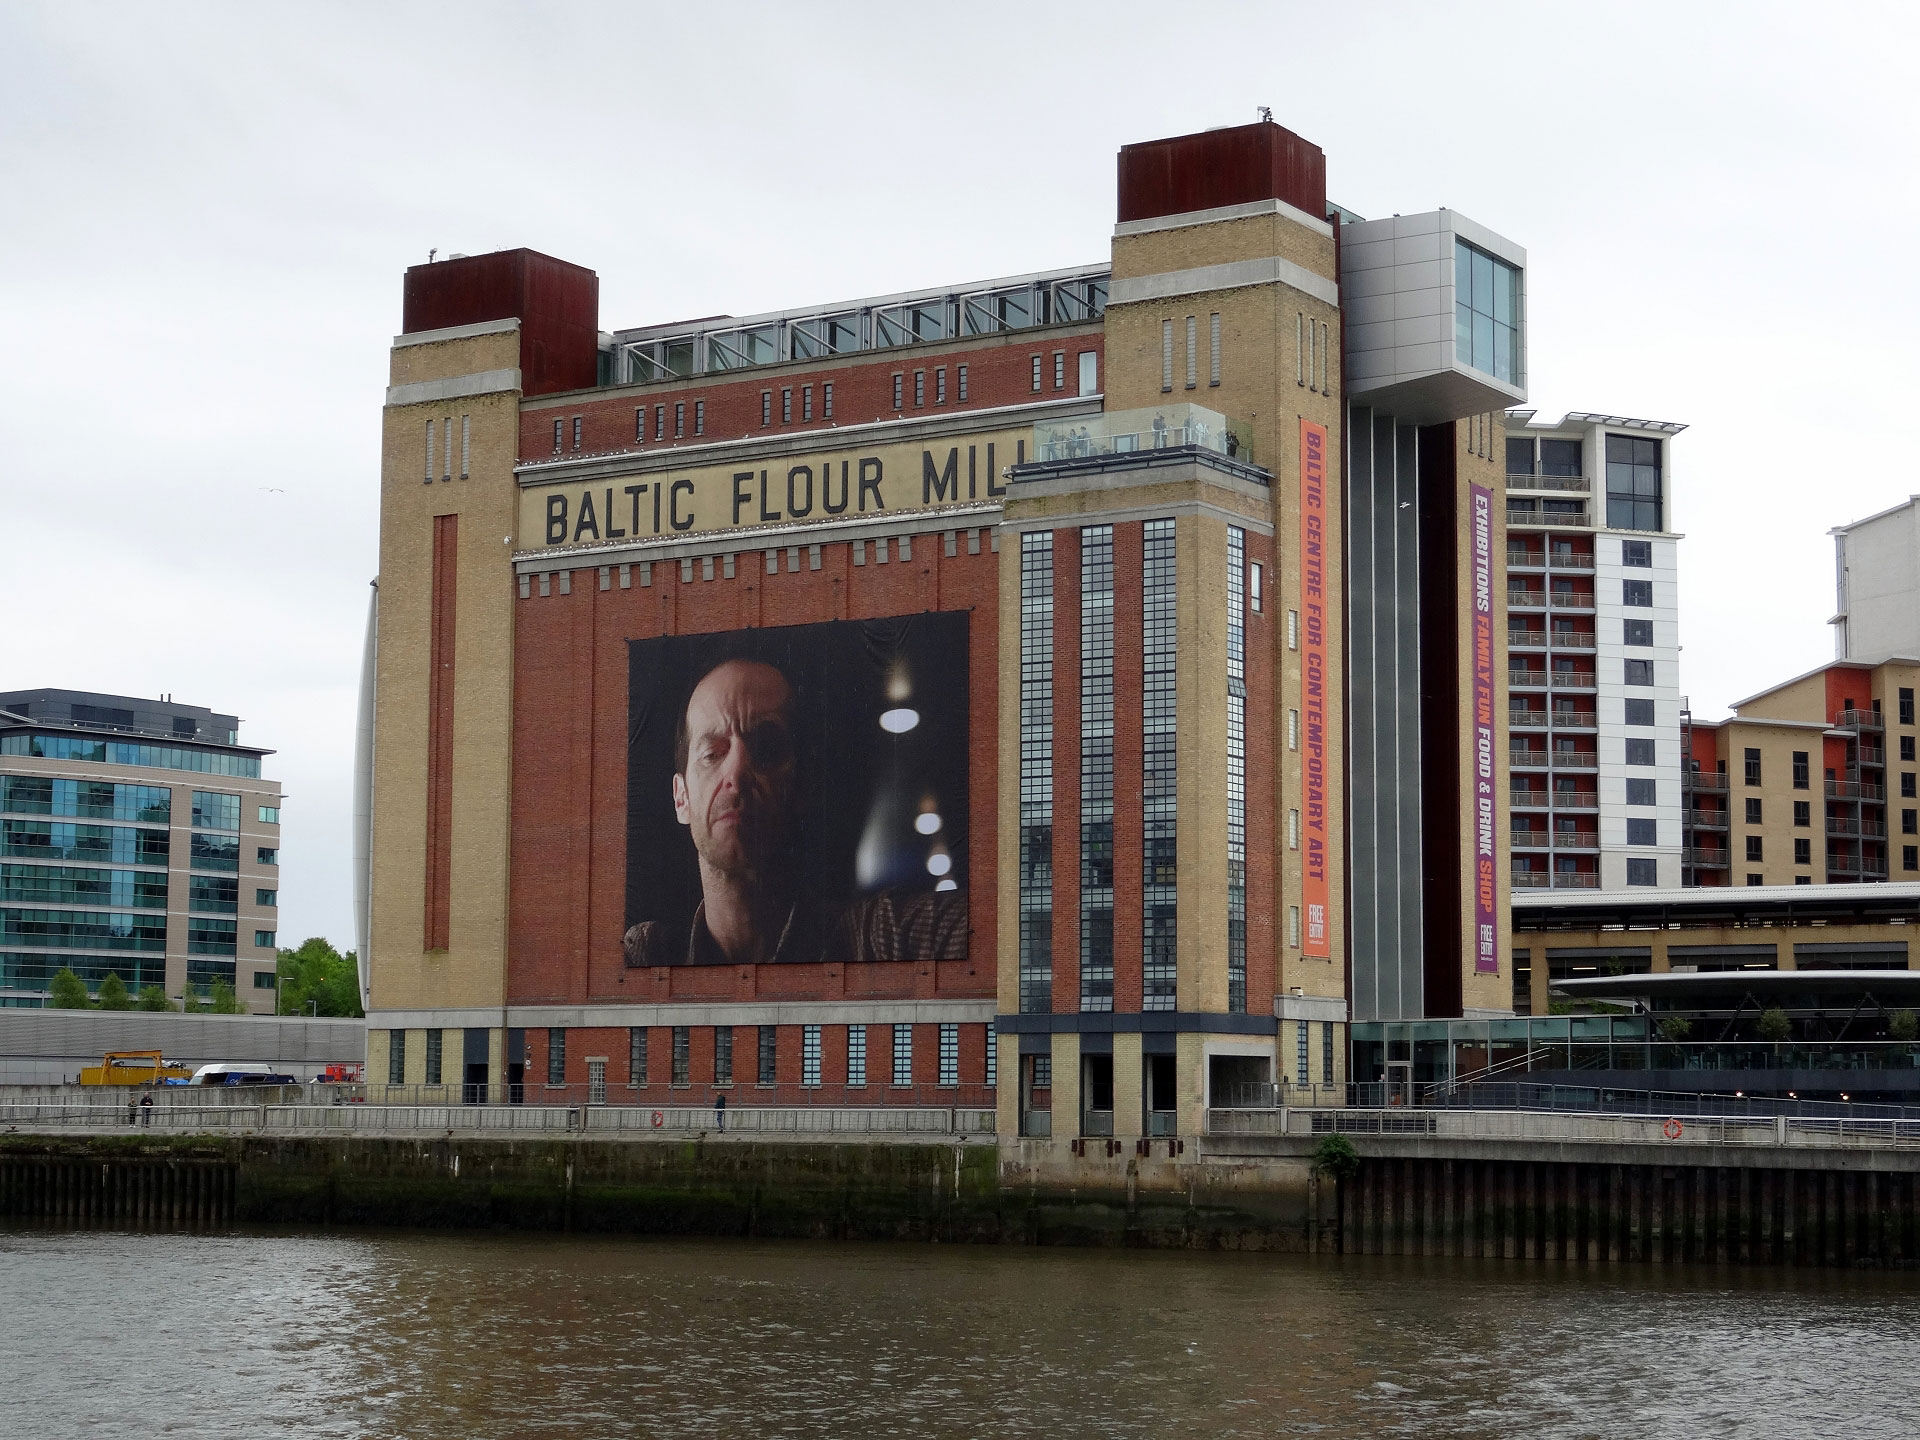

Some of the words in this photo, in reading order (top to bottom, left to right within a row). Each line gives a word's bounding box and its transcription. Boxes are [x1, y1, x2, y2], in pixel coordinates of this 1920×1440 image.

[1306, 432, 1321, 508] BALTIC
[547, 480, 694, 544] BALTIC
[733, 457, 885, 524] FLOUR
[1307, 514, 1321, 598] CENTRE
[1476, 494, 1489, 612] EXHIBITIONS
[1307, 603, 1322, 647] FOR
[1477, 614, 1490, 682] FAMILY
[1477, 688, 1490, 724] FUN
[1307, 651, 1323, 832] CONTEMPORARY
[1478, 727, 1491, 778] FOOD
[1479, 781, 1491, 794] &
[1479, 798, 1492, 857] DRINK
[1308, 837, 1324, 882] ART
[1480, 860, 1492, 913] SHOP
[1309, 904, 1324, 923] FREE
[1481, 924, 1493, 942] FREE
